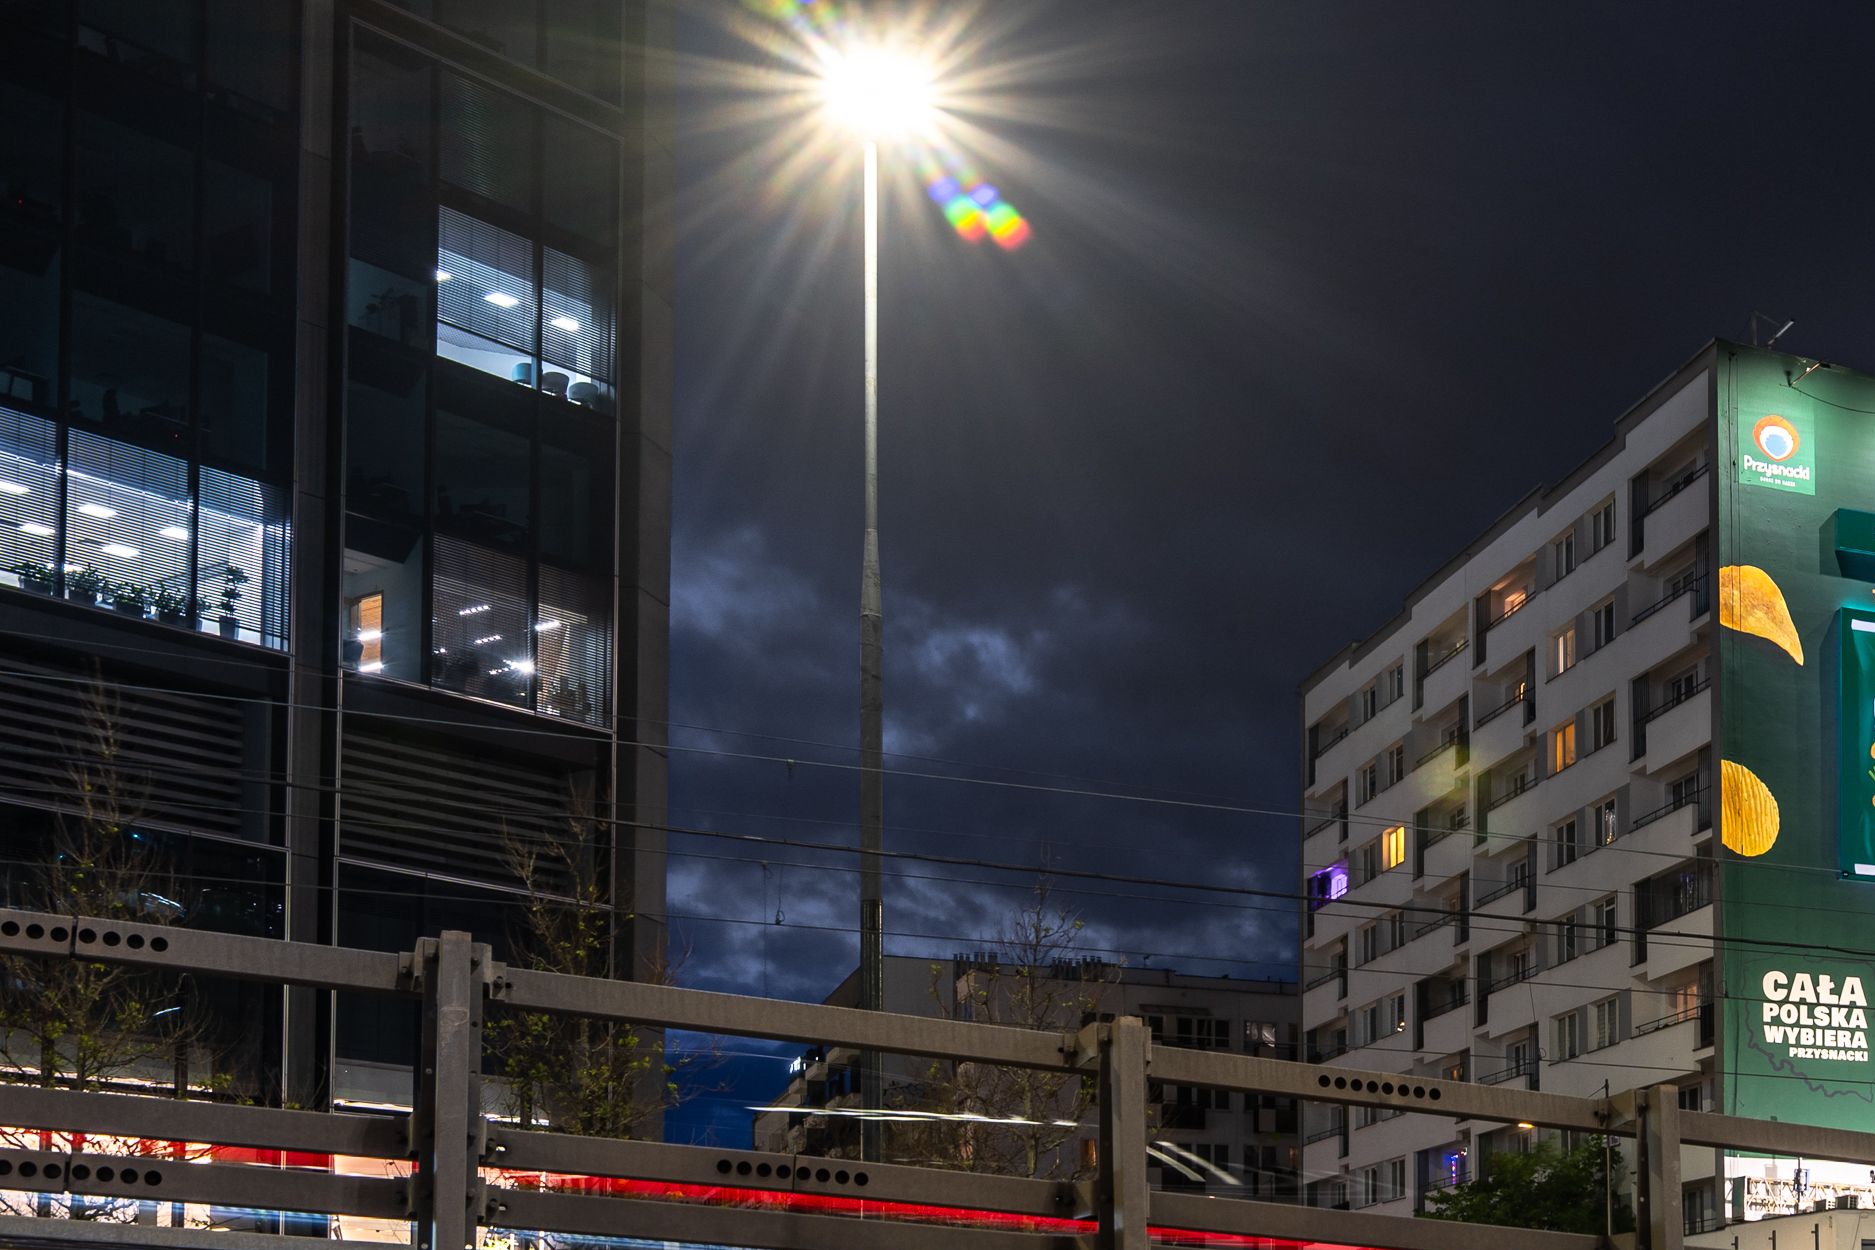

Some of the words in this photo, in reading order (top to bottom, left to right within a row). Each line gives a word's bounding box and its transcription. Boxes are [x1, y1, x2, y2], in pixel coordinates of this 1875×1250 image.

[1762, 970, 1868, 1007] CAŁA
[1762, 1002, 1868, 1029] POLSKA
[1763, 1024, 1868, 1049] WYBIERA
[1788, 1047, 1869, 1062] PRZYSNACKI
